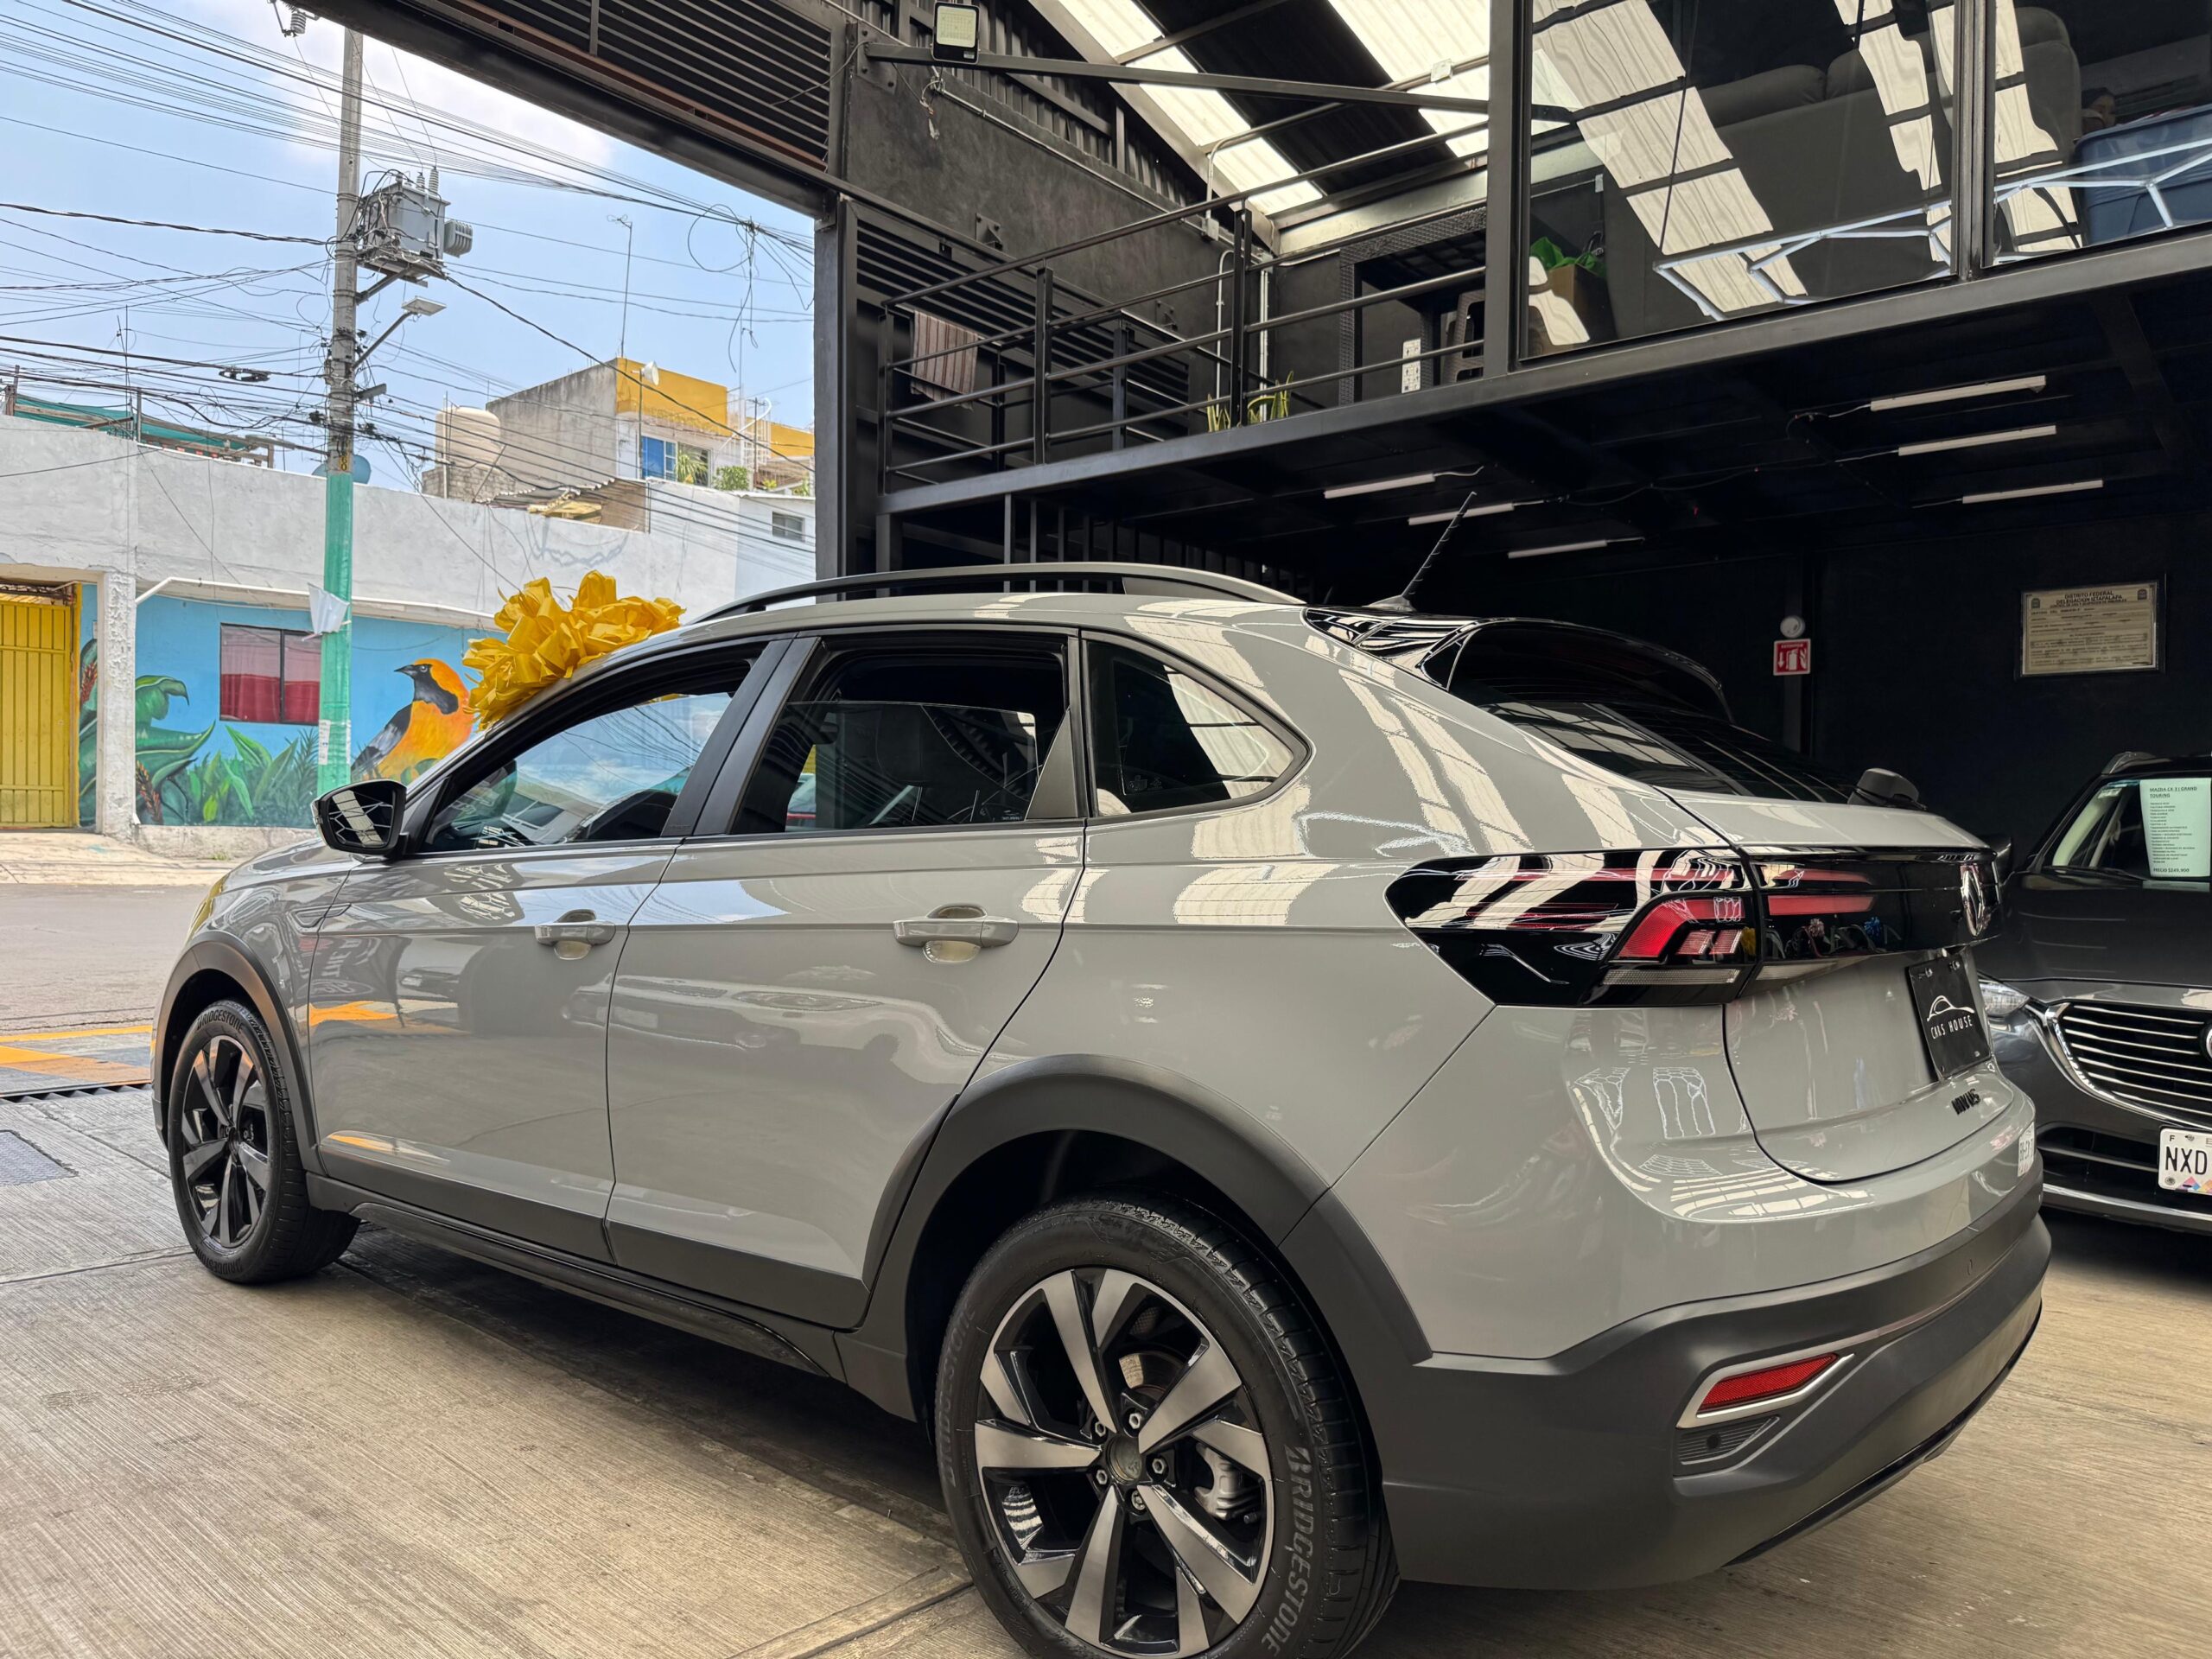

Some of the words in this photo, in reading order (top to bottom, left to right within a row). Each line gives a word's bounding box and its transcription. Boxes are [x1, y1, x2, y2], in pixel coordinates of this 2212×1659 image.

[196, 1009, 243, 1034] BRIDGESTONE
[1930, 1023, 1946, 1039] CARS
[1948, 1014, 1974, 1033] HOUSE
[1951, 1088, 1981, 1116] NIVUS
[2164, 1146, 2208, 1175] NXD
[1261, 1444, 1314, 1657] BRIDGESTONE
